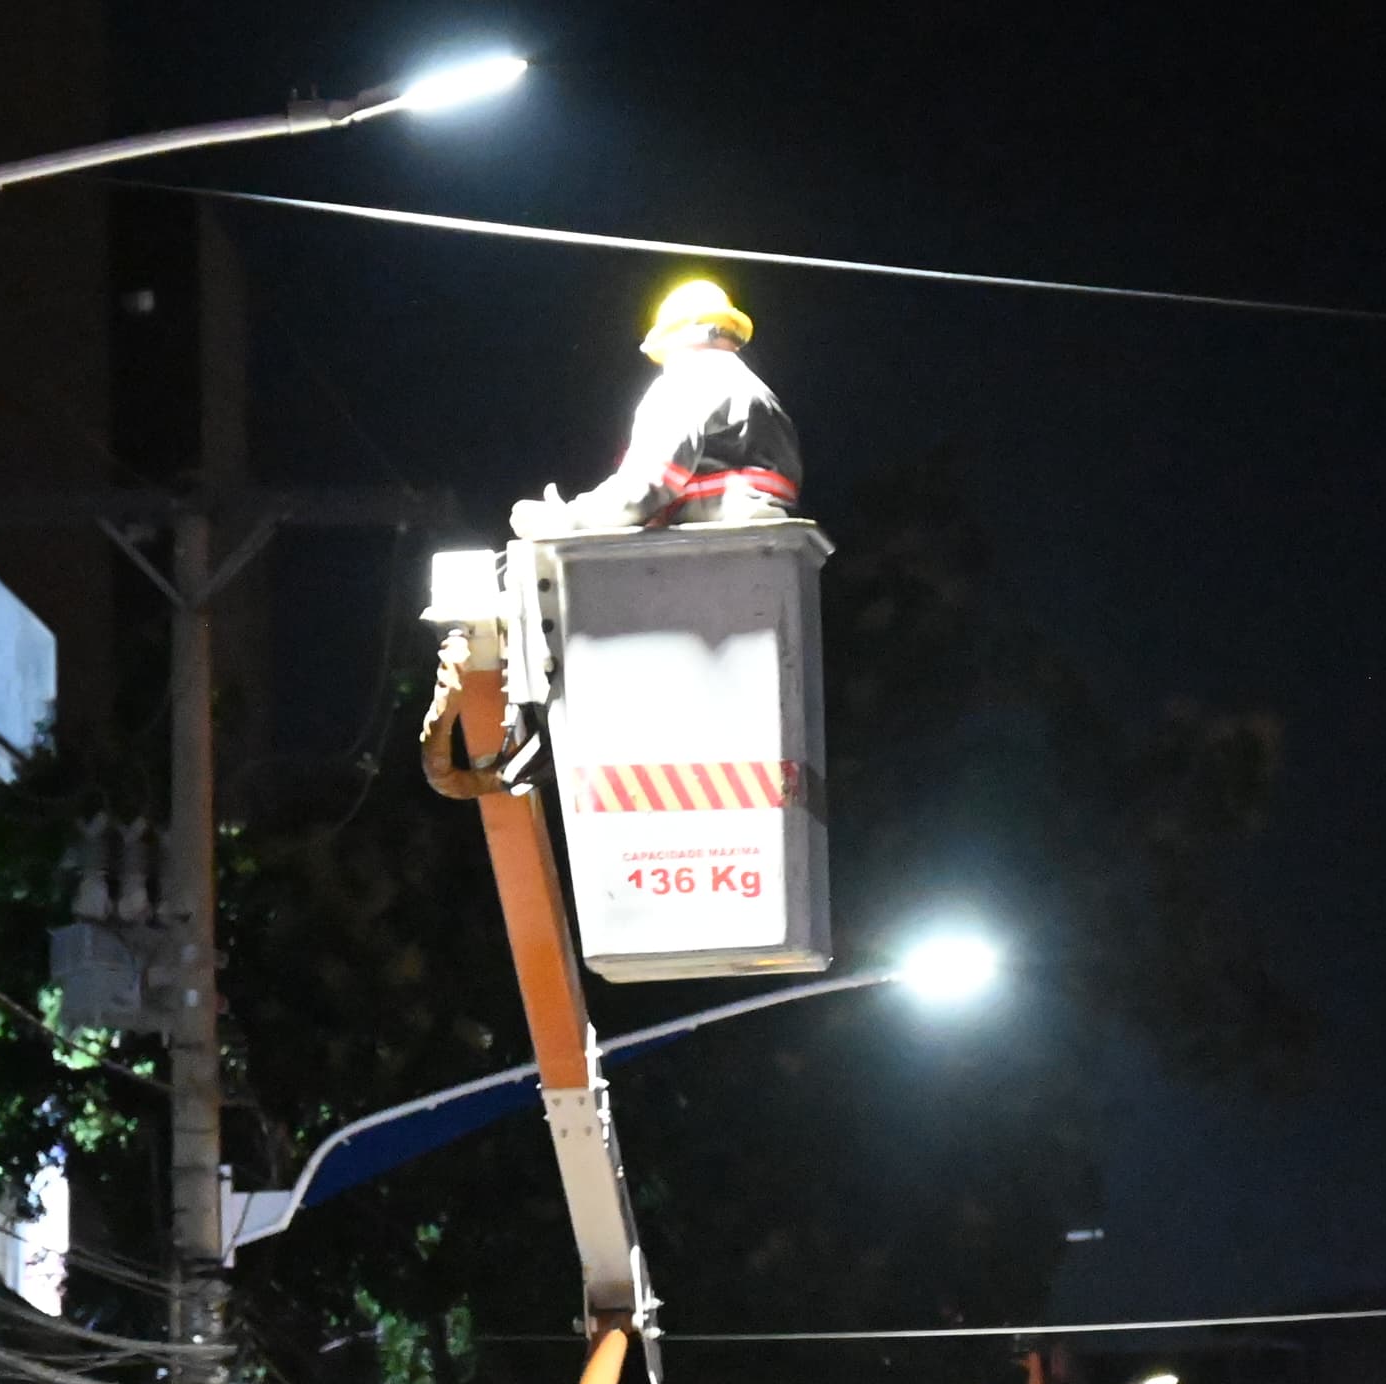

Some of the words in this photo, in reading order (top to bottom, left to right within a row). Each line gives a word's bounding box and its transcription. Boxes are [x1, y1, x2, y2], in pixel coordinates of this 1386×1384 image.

[622, 848, 704, 862] CAPACIDADE
[627, 866, 696, 895] 136
[710, 865, 762, 898] Kg
